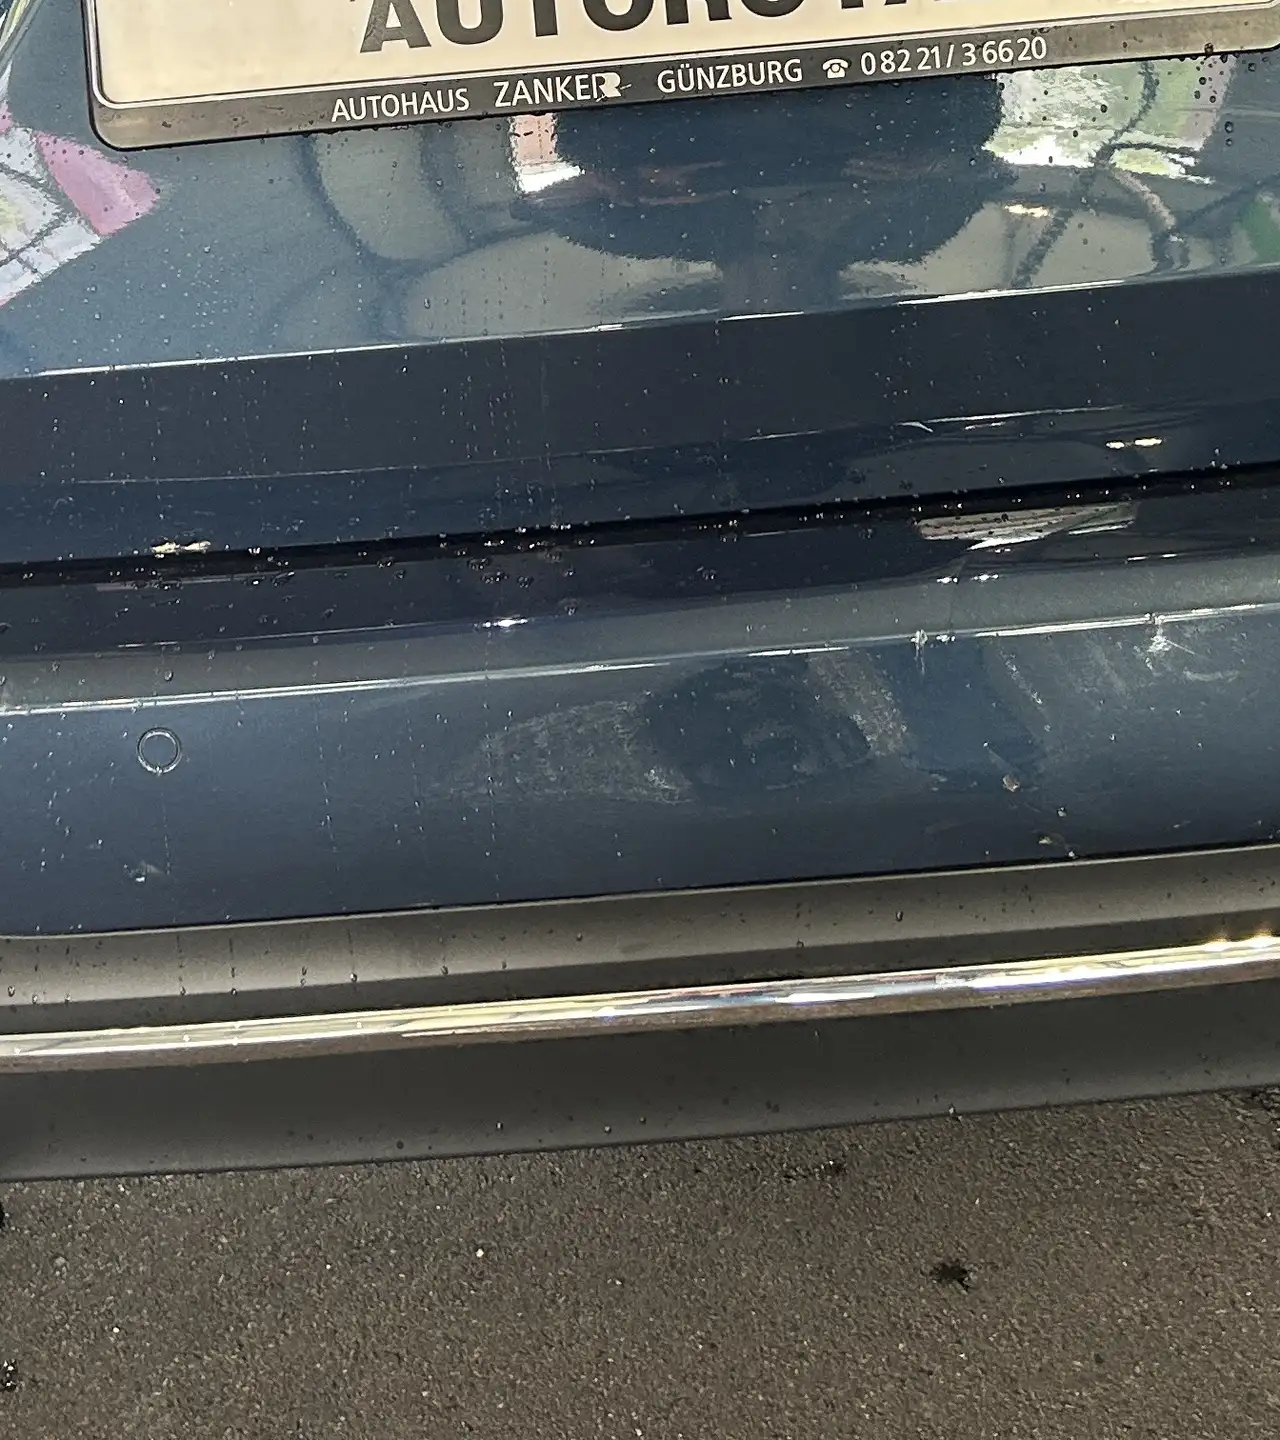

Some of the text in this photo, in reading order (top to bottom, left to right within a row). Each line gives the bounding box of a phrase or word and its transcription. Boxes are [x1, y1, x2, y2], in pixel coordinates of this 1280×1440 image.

[330, 87, 470, 123] AUTOHAUS
[493, 71, 624, 108] ZANKER
[656, 57, 803, 94] GÜNZBURG
